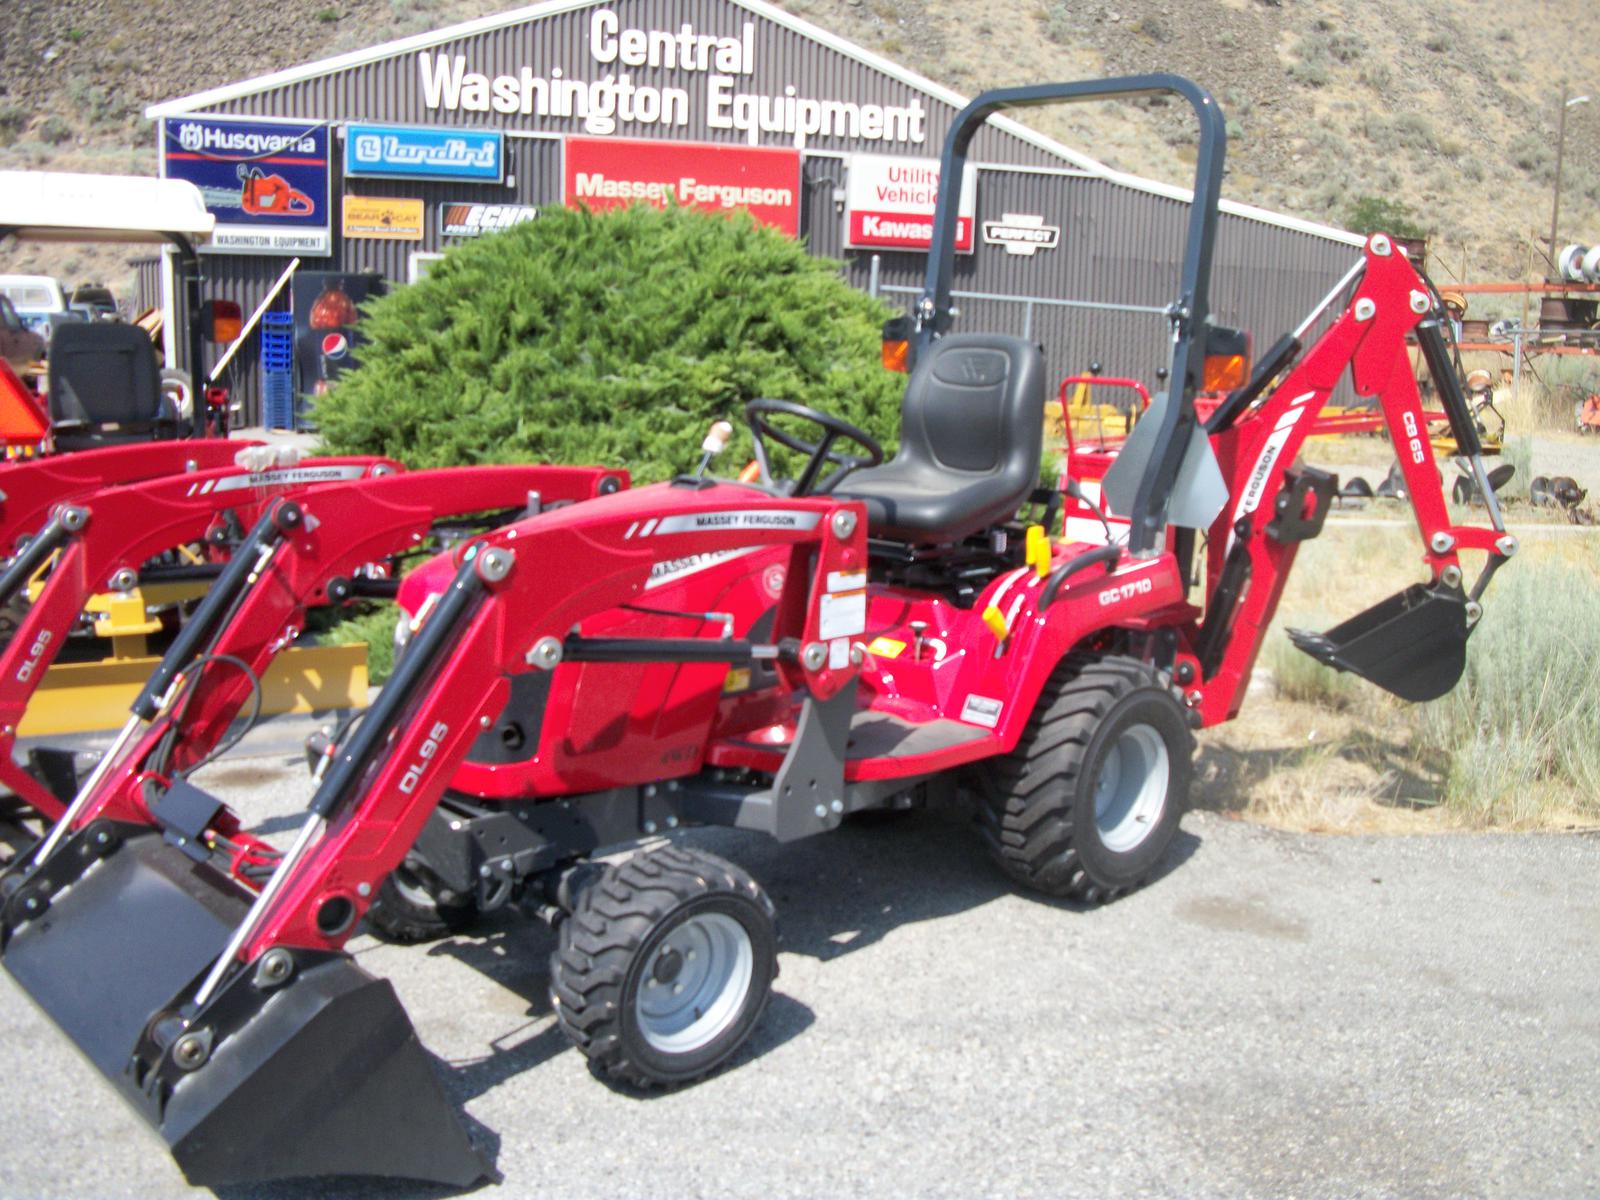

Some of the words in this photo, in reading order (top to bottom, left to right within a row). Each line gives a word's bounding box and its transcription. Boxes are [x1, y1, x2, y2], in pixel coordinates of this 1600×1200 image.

[591, 9, 754, 74] Central
[418, 53, 689, 134] Washington
[707, 75, 925, 148] Equipment
[204, 127, 316, 153] Husqvarna
[576, 173, 676, 204] Massey
[679, 178, 792, 207] Ferguson
[217, 234, 271, 247] WASHINGTON
[274, 235, 321, 248] EQUIPMENT
[863, 215, 964, 241] Kawasi
[991, 227, 1052, 243] PERFECT
[1402, 411, 1419, 438] CB
[1409, 438, 1425, 464] 65
[249, 473, 288, 483] MASSEY
[293, 470, 342, 479] FERGUSON
[1243, 445, 1276, 514] FERGUSON
[696, 515, 738, 526] MASSEY
[744, 515, 795, 525] FERGUSON
[16, 629, 53, 682] DL95
[398, 720, 449, 795] DL95
